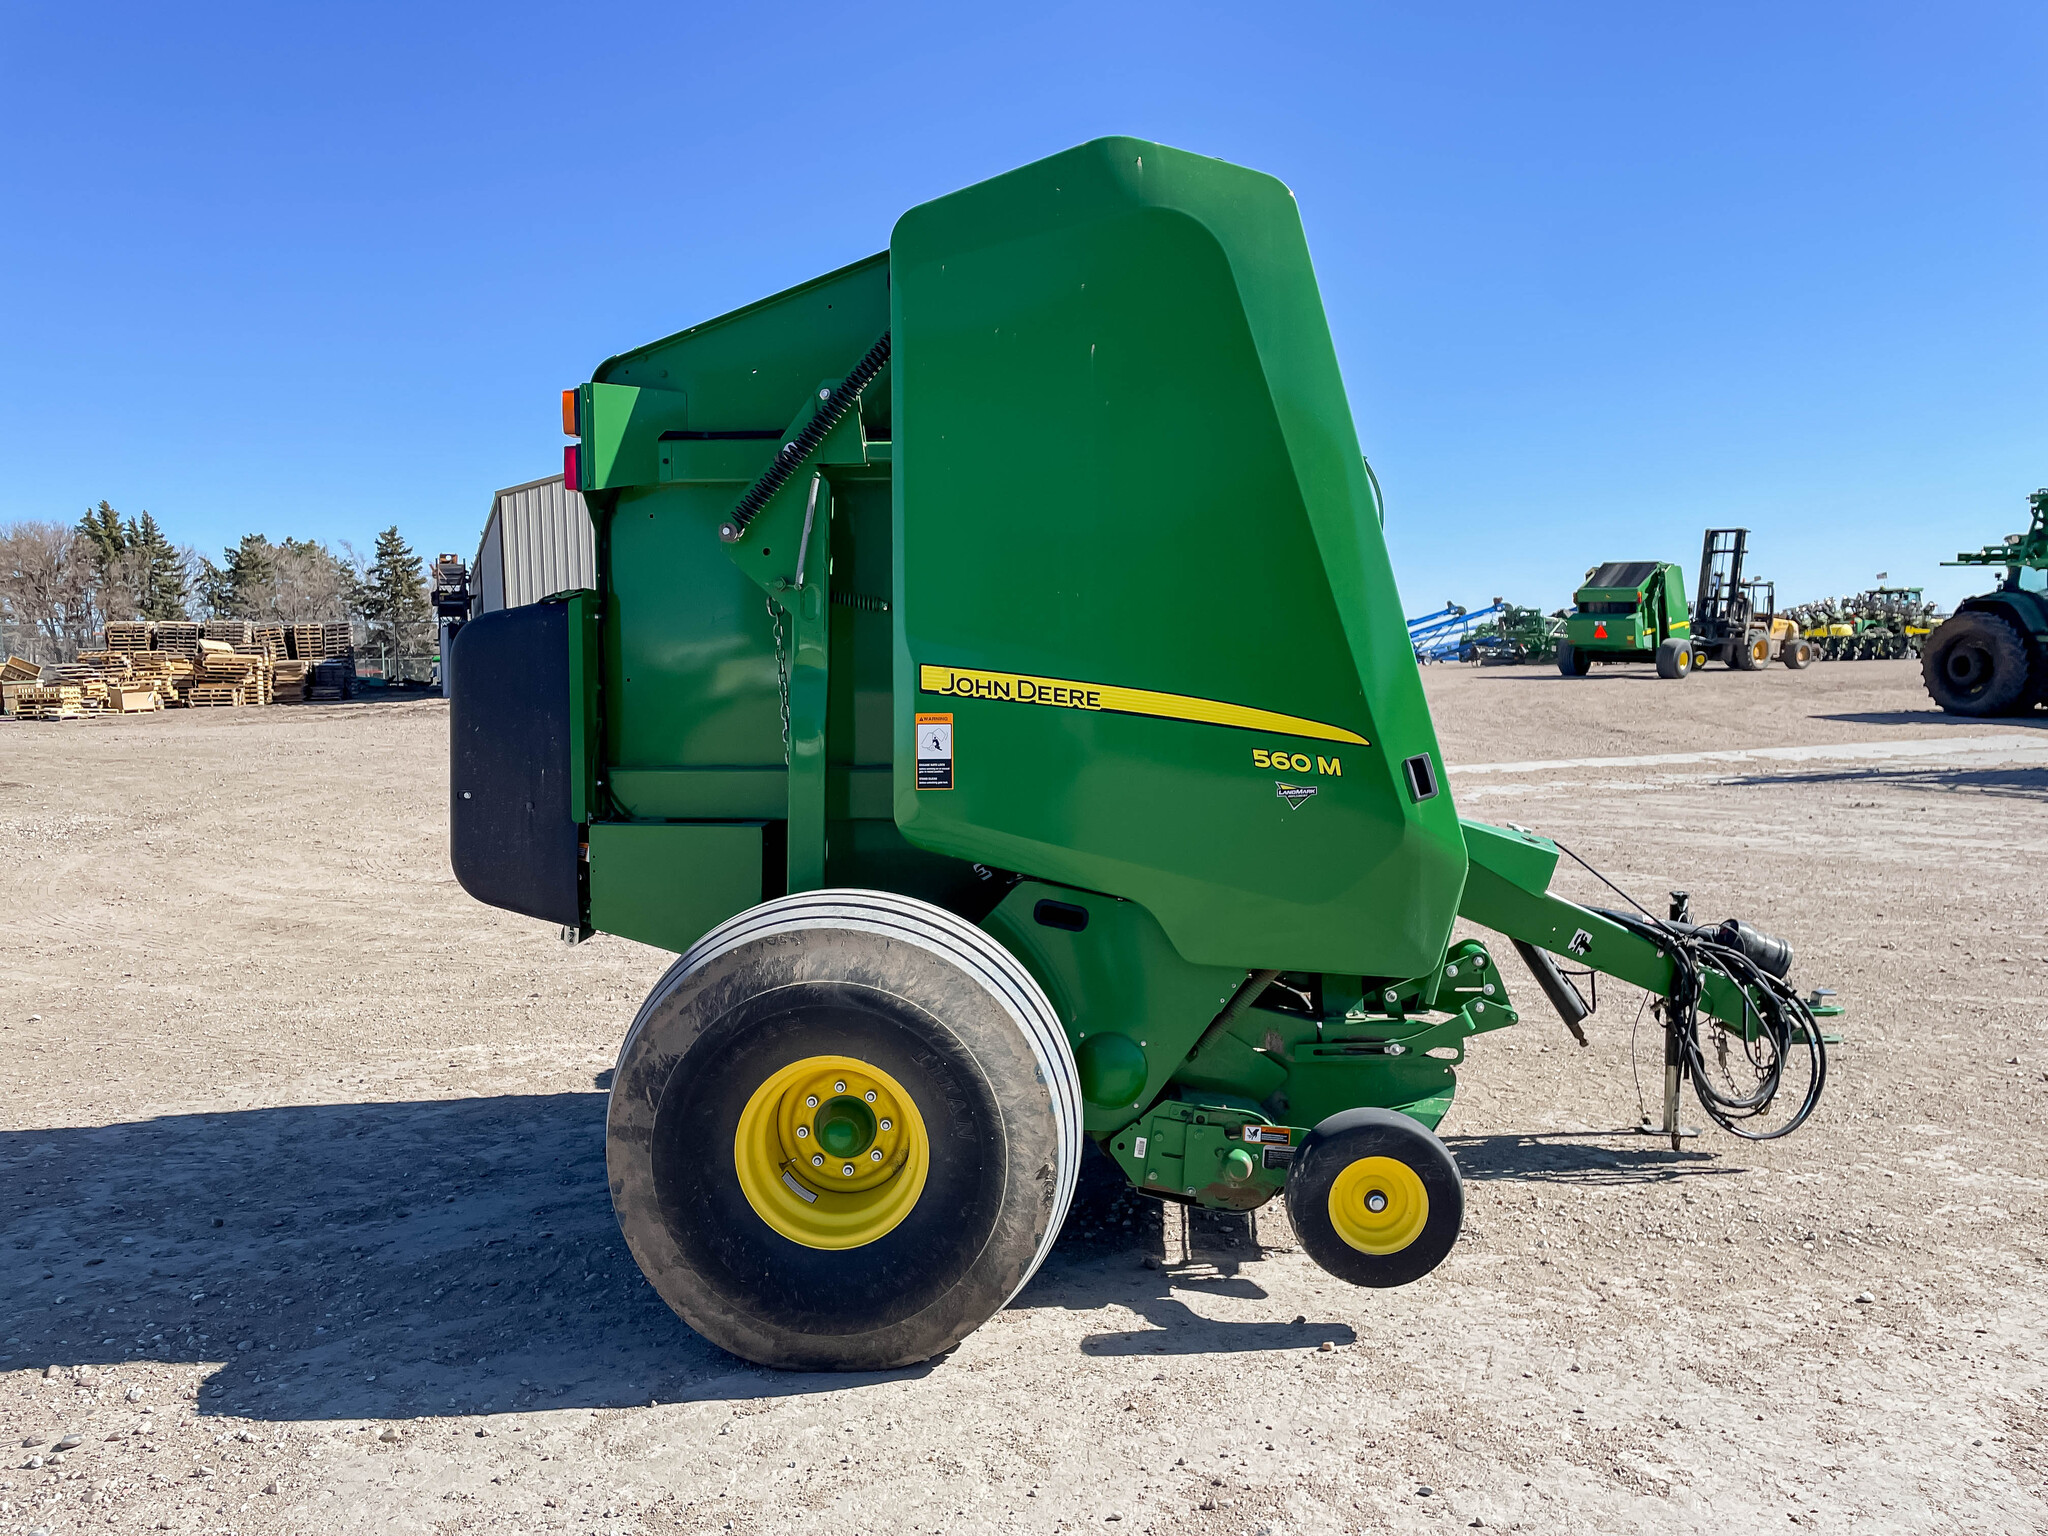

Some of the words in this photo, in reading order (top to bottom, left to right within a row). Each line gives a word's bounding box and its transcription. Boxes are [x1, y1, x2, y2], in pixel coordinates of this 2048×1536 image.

[942, 673, 1010, 698] JOHN
[1017, 679, 1101, 707] DEERE
[1252, 748, 1312, 773] 560
[1316, 755, 1342, 777] M
[911, 1047, 977, 1143] TITAN
